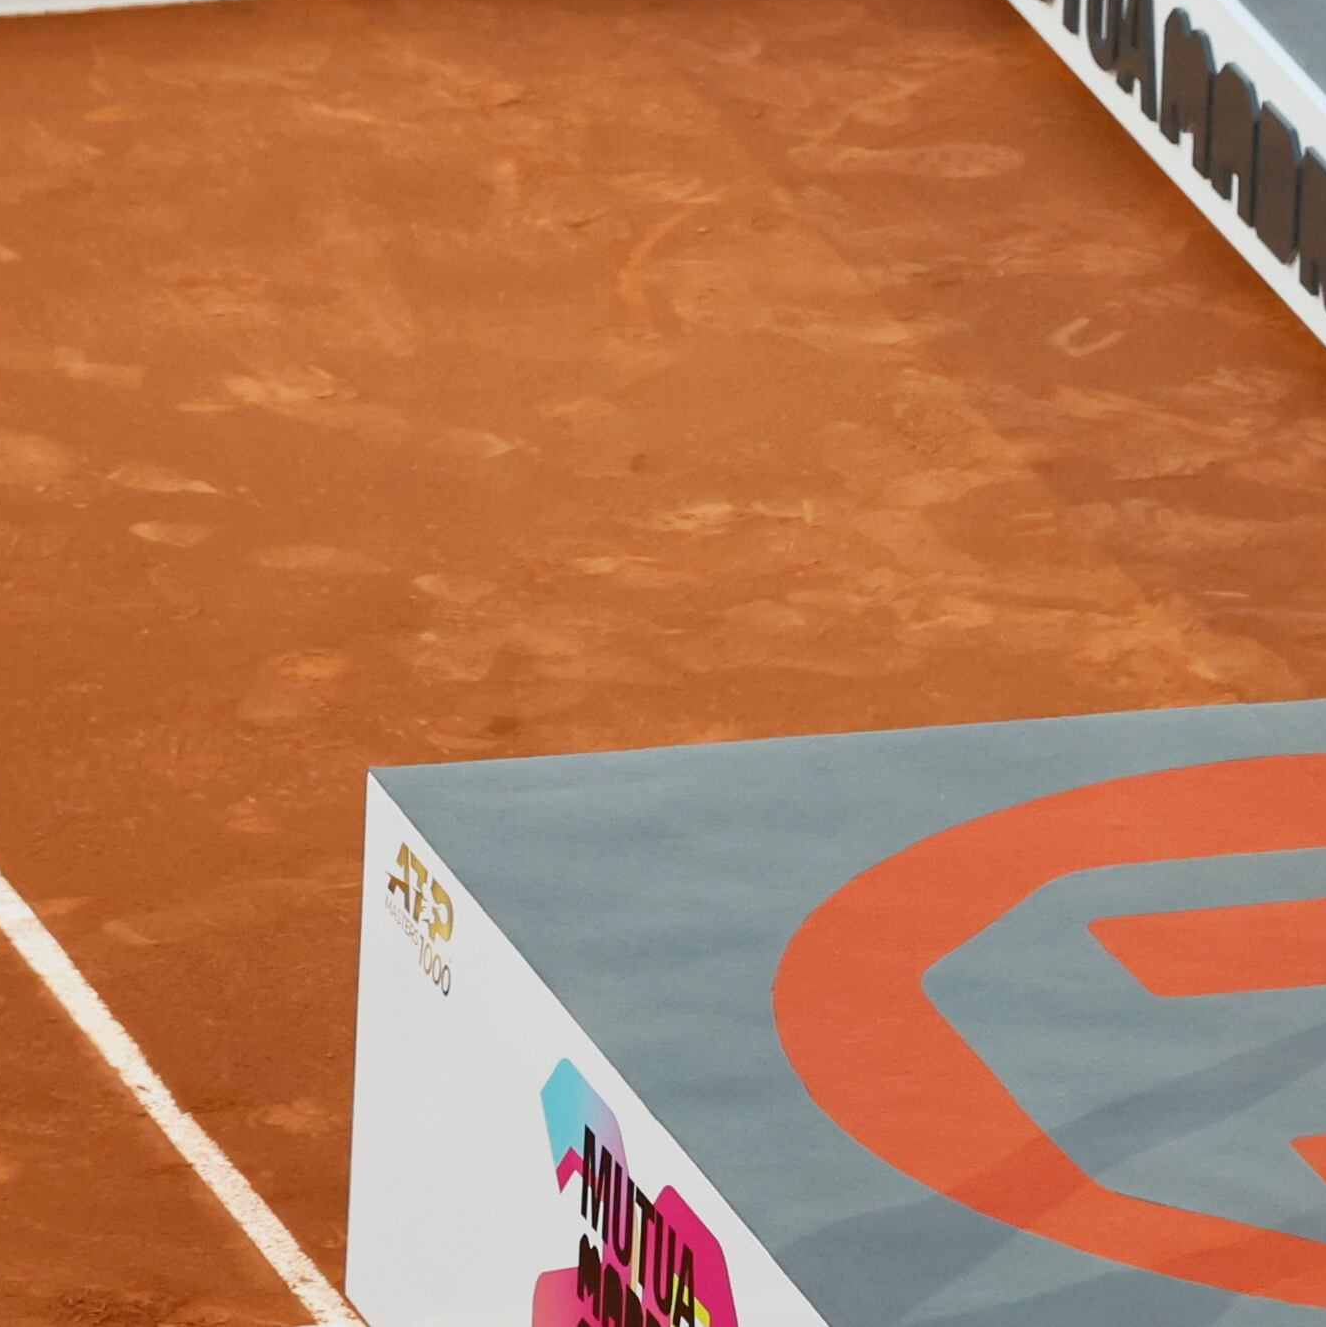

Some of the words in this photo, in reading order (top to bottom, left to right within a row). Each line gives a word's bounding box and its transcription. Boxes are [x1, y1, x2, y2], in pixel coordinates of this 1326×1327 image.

[385, 841, 454, 943] ATP
[418, 935, 452, 997] 1000
[580, 1123, 695, 1327] MUTUA
